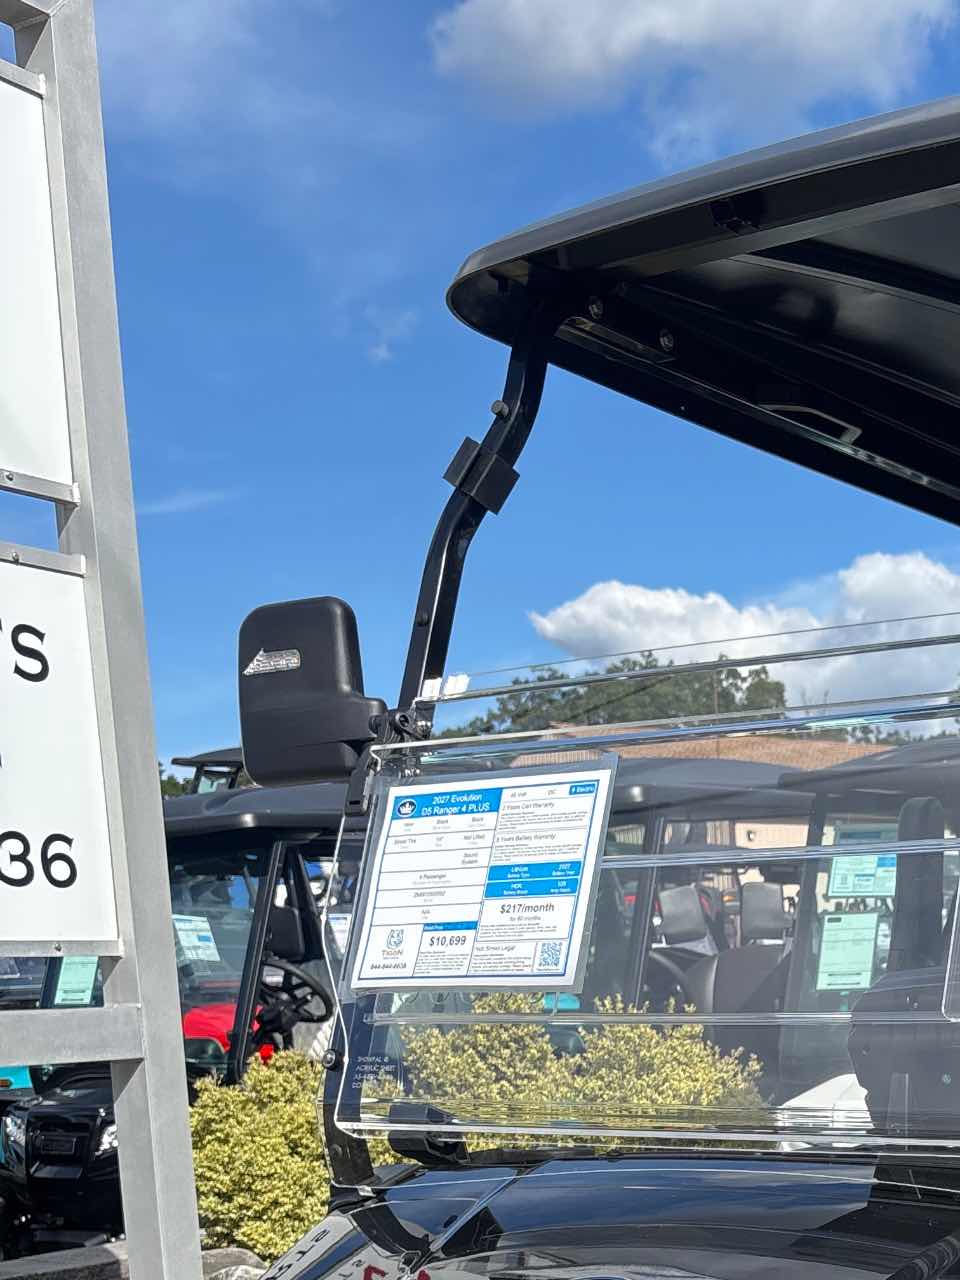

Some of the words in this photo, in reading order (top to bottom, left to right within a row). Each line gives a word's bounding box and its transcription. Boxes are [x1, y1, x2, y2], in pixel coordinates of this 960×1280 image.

[450, 793, 483, 804] Evolution
[421, 807, 432, 816] D5
[433, 805, 460, 816] Ranger
[468, 802, 491, 812] PLUS
[500, 902, 555, 914] $217/month
[429, 935, 467, 947] $10,699
